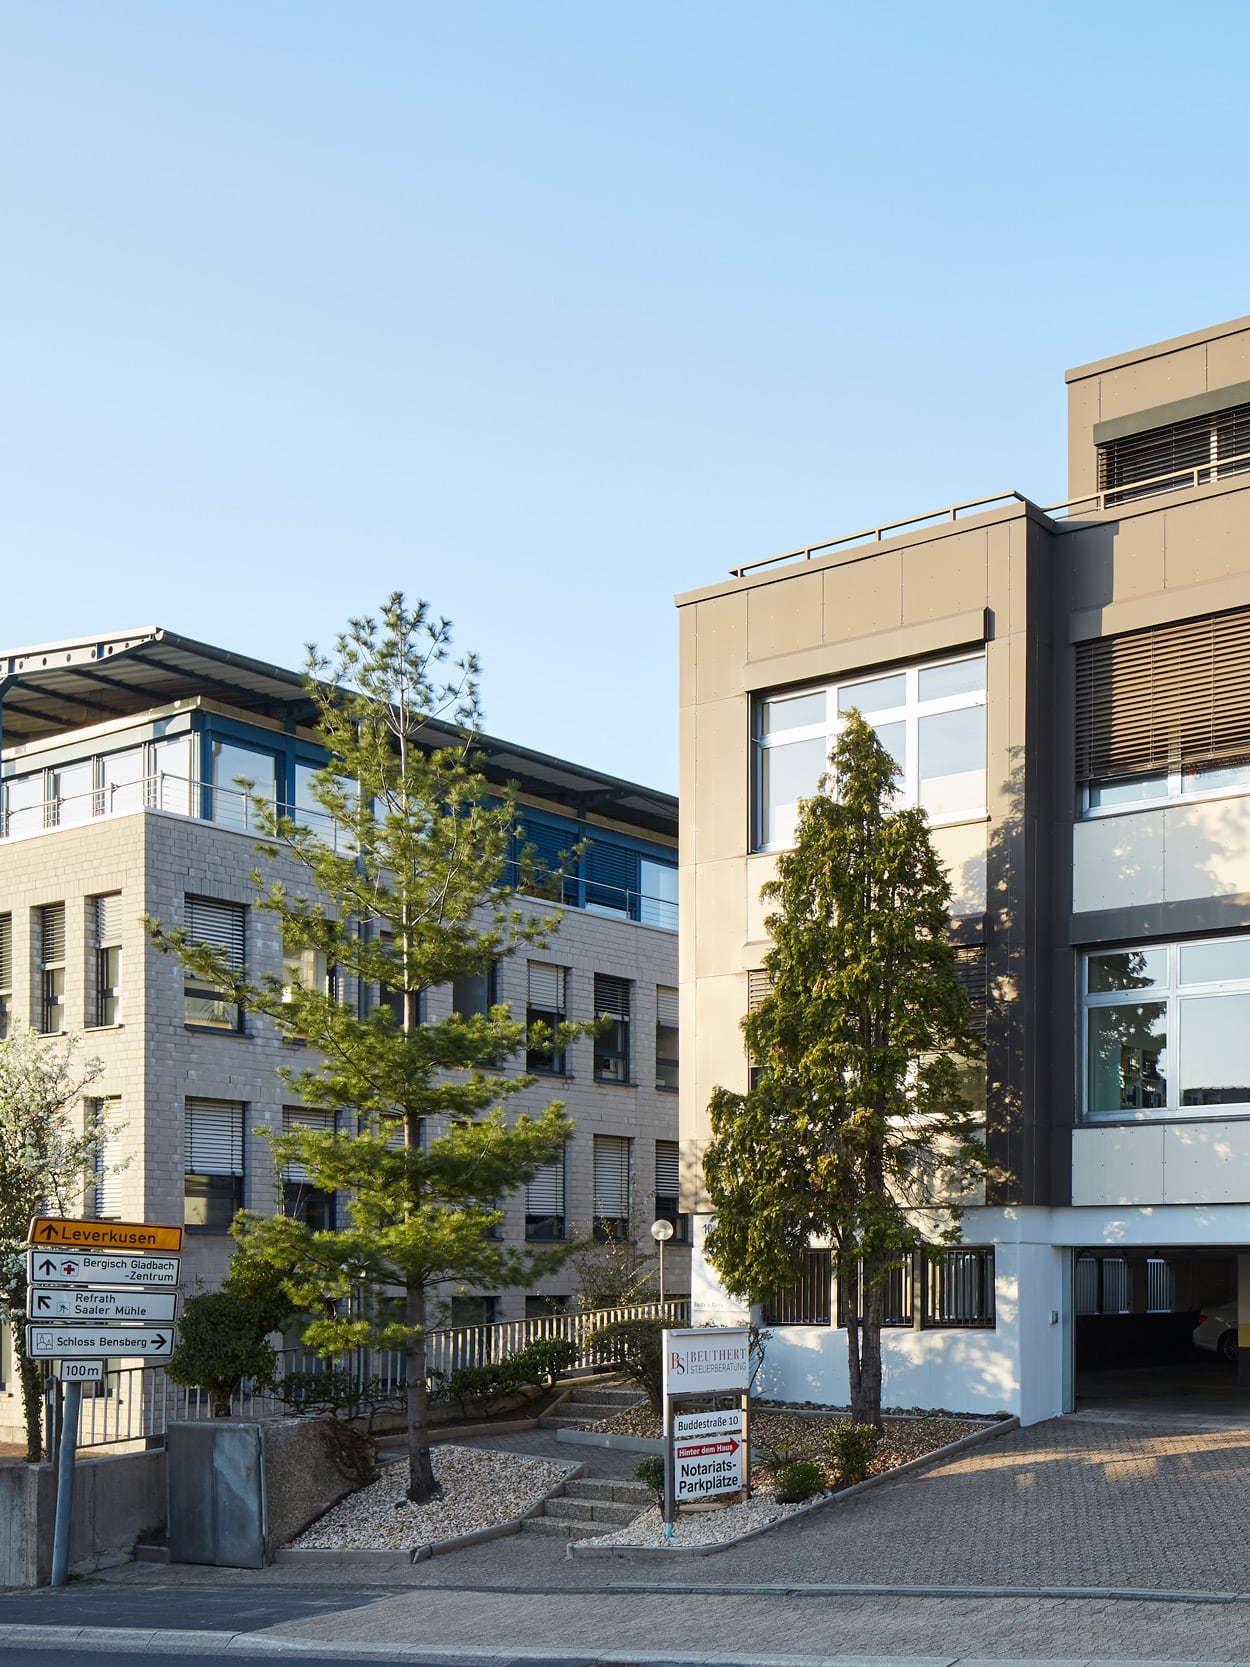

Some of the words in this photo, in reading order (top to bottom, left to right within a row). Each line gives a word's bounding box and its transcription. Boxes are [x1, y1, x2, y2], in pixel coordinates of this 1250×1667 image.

[62, 1227, 156, 1245] Leverkusen
[83, 1258, 127, 1270] Bergisch
[131, 1259, 175, 1271] Gladbach
[125, 1271, 174, 1282] -Zentrum
[75, 1293, 116, 1304] Refrath
[74, 1305, 110, 1315] Saaler
[115, 1306, 147, 1316] Mühle
[57, 1337, 96, 1347] Schloss
[100, 1337, 147, 1349] Bensberg
[690, 1348, 746, 1363] BEUTHERT
[690, 1361, 747, 1375] STEUERBERATUNG
[678, 1416, 727, 1432] Buddestraße
[729, 1416, 739, 1426] 10
[679, 1448, 700, 1457] Hinter
[701, 1446, 716, 1454] dem
[716, 1444, 734, 1452] Haus
[681, 1460, 737, 1478] Notariats-
[679, 1475, 739, 1494] Parkplätze
